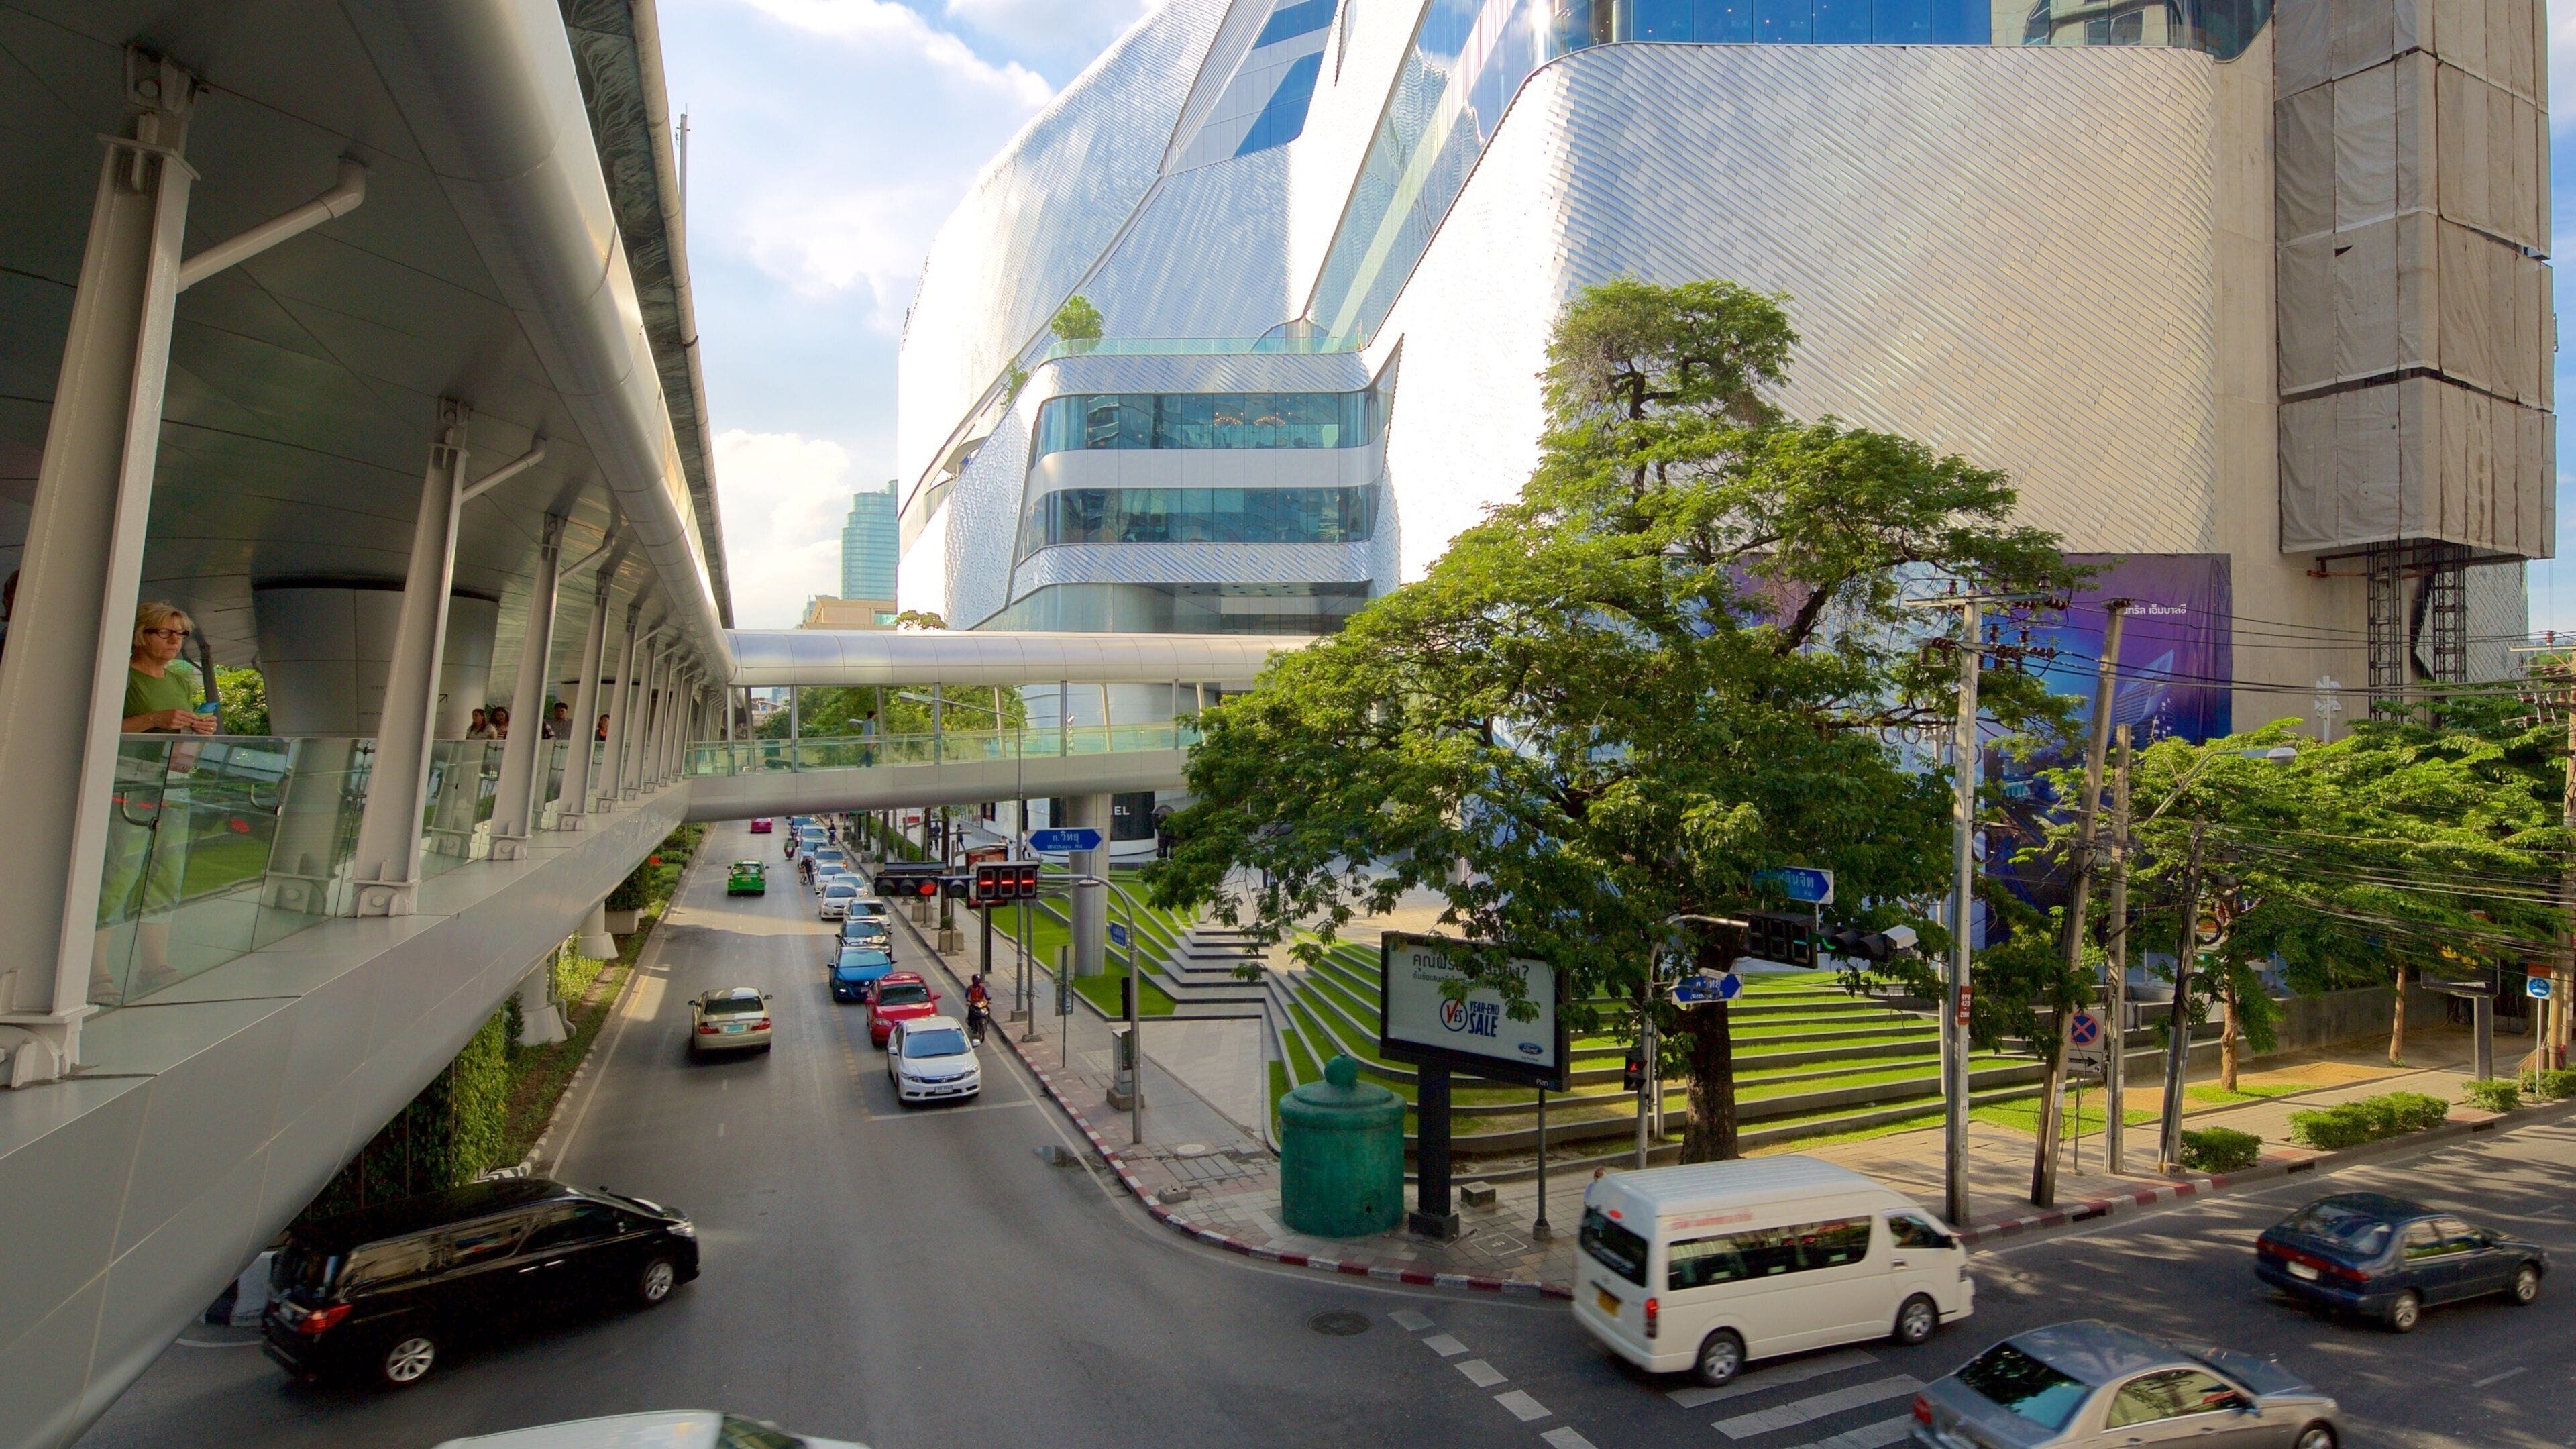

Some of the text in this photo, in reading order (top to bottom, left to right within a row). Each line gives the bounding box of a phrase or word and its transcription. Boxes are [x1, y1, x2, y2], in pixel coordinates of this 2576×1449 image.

[1113, 806, 1130, 815] EL
[1469, 1000, 1499, 1015] YEAR-END
[1468, 1013, 1498, 1037] SALE
